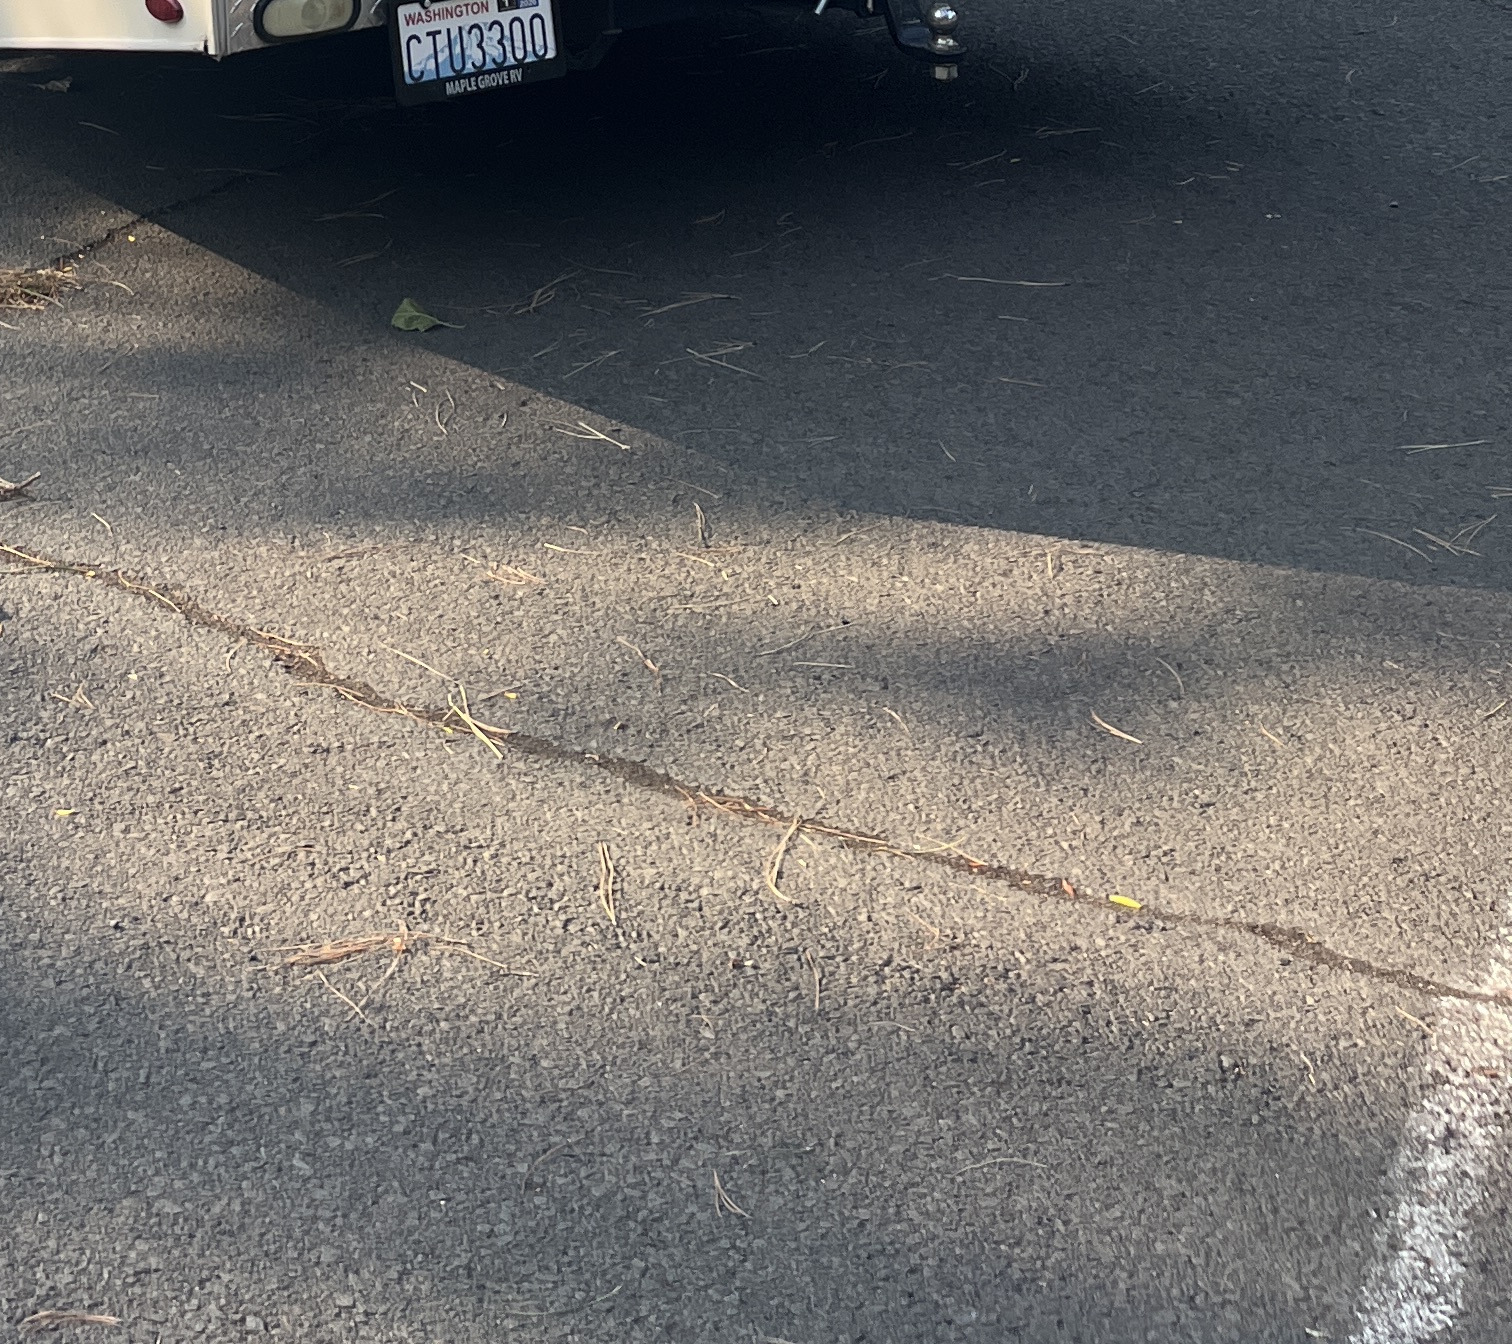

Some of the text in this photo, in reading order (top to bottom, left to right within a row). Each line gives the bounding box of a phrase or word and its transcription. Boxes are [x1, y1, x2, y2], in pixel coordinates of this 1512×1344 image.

[403, 0, 489, 27] WASHINGTON
[405, 12, 549, 82] CTU3300
[445, 67, 524, 96] MAPLE GROVE RV
